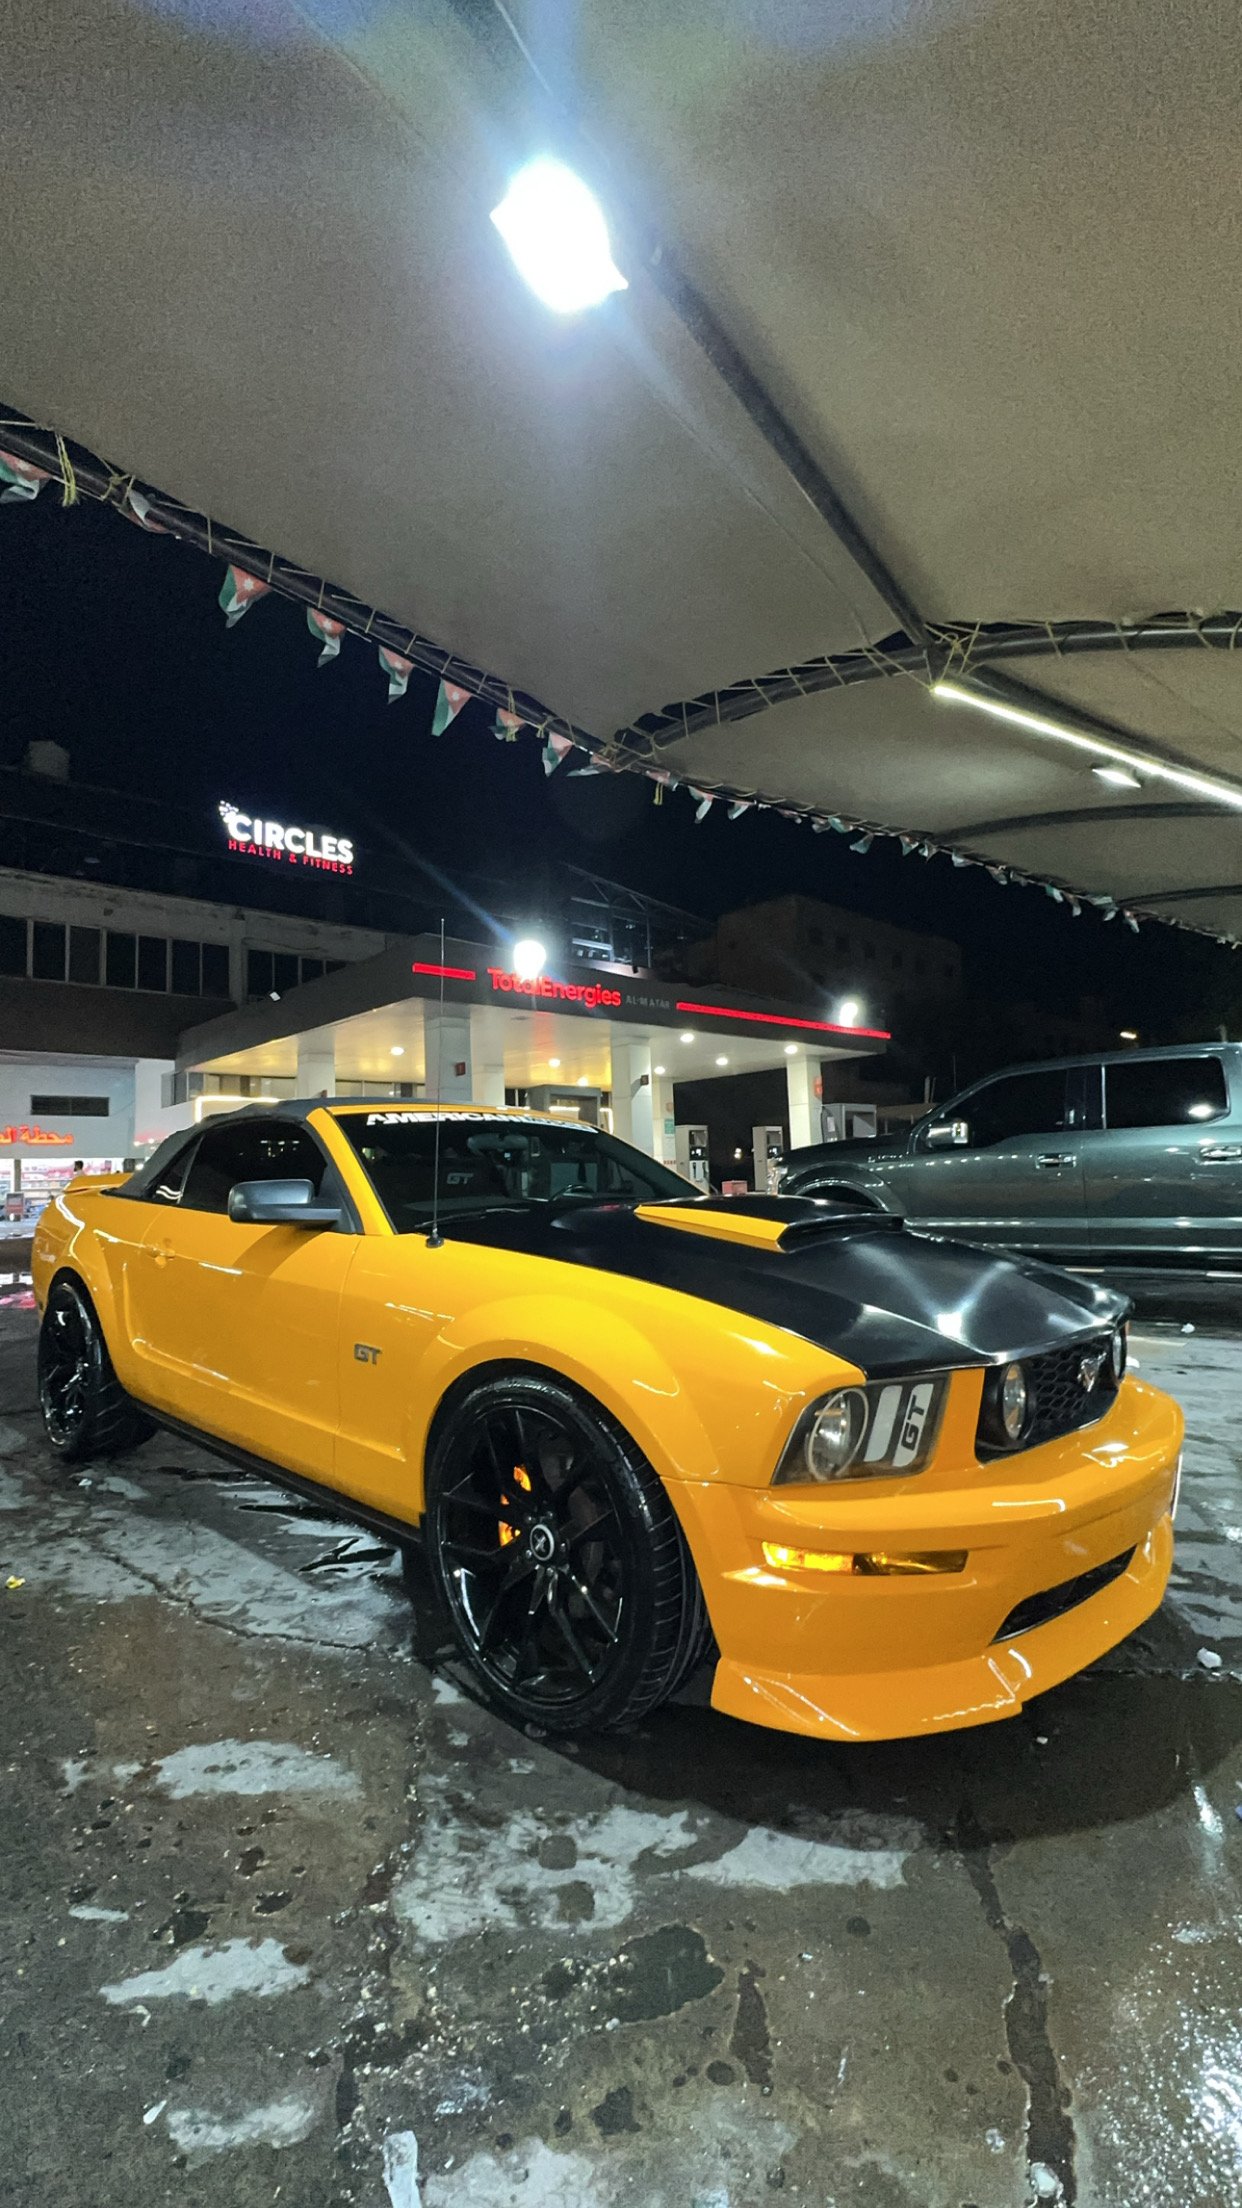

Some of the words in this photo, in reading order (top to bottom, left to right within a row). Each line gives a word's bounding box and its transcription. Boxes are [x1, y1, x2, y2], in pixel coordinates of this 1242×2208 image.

[227, 813, 355, 866] CIRCLES
[228, 839, 281, 860] HEALTH
[288, 852, 297, 864] &
[303, 855, 353, 875] FITNESS
[487, 967, 622, 1008] TotalEnergies
[19, 1125, 74, 1144] محطة
[447, 1172, 474, 1185] GT
[354, 1343, 383, 1365] GT
[901, 1395, 925, 1451] GT
